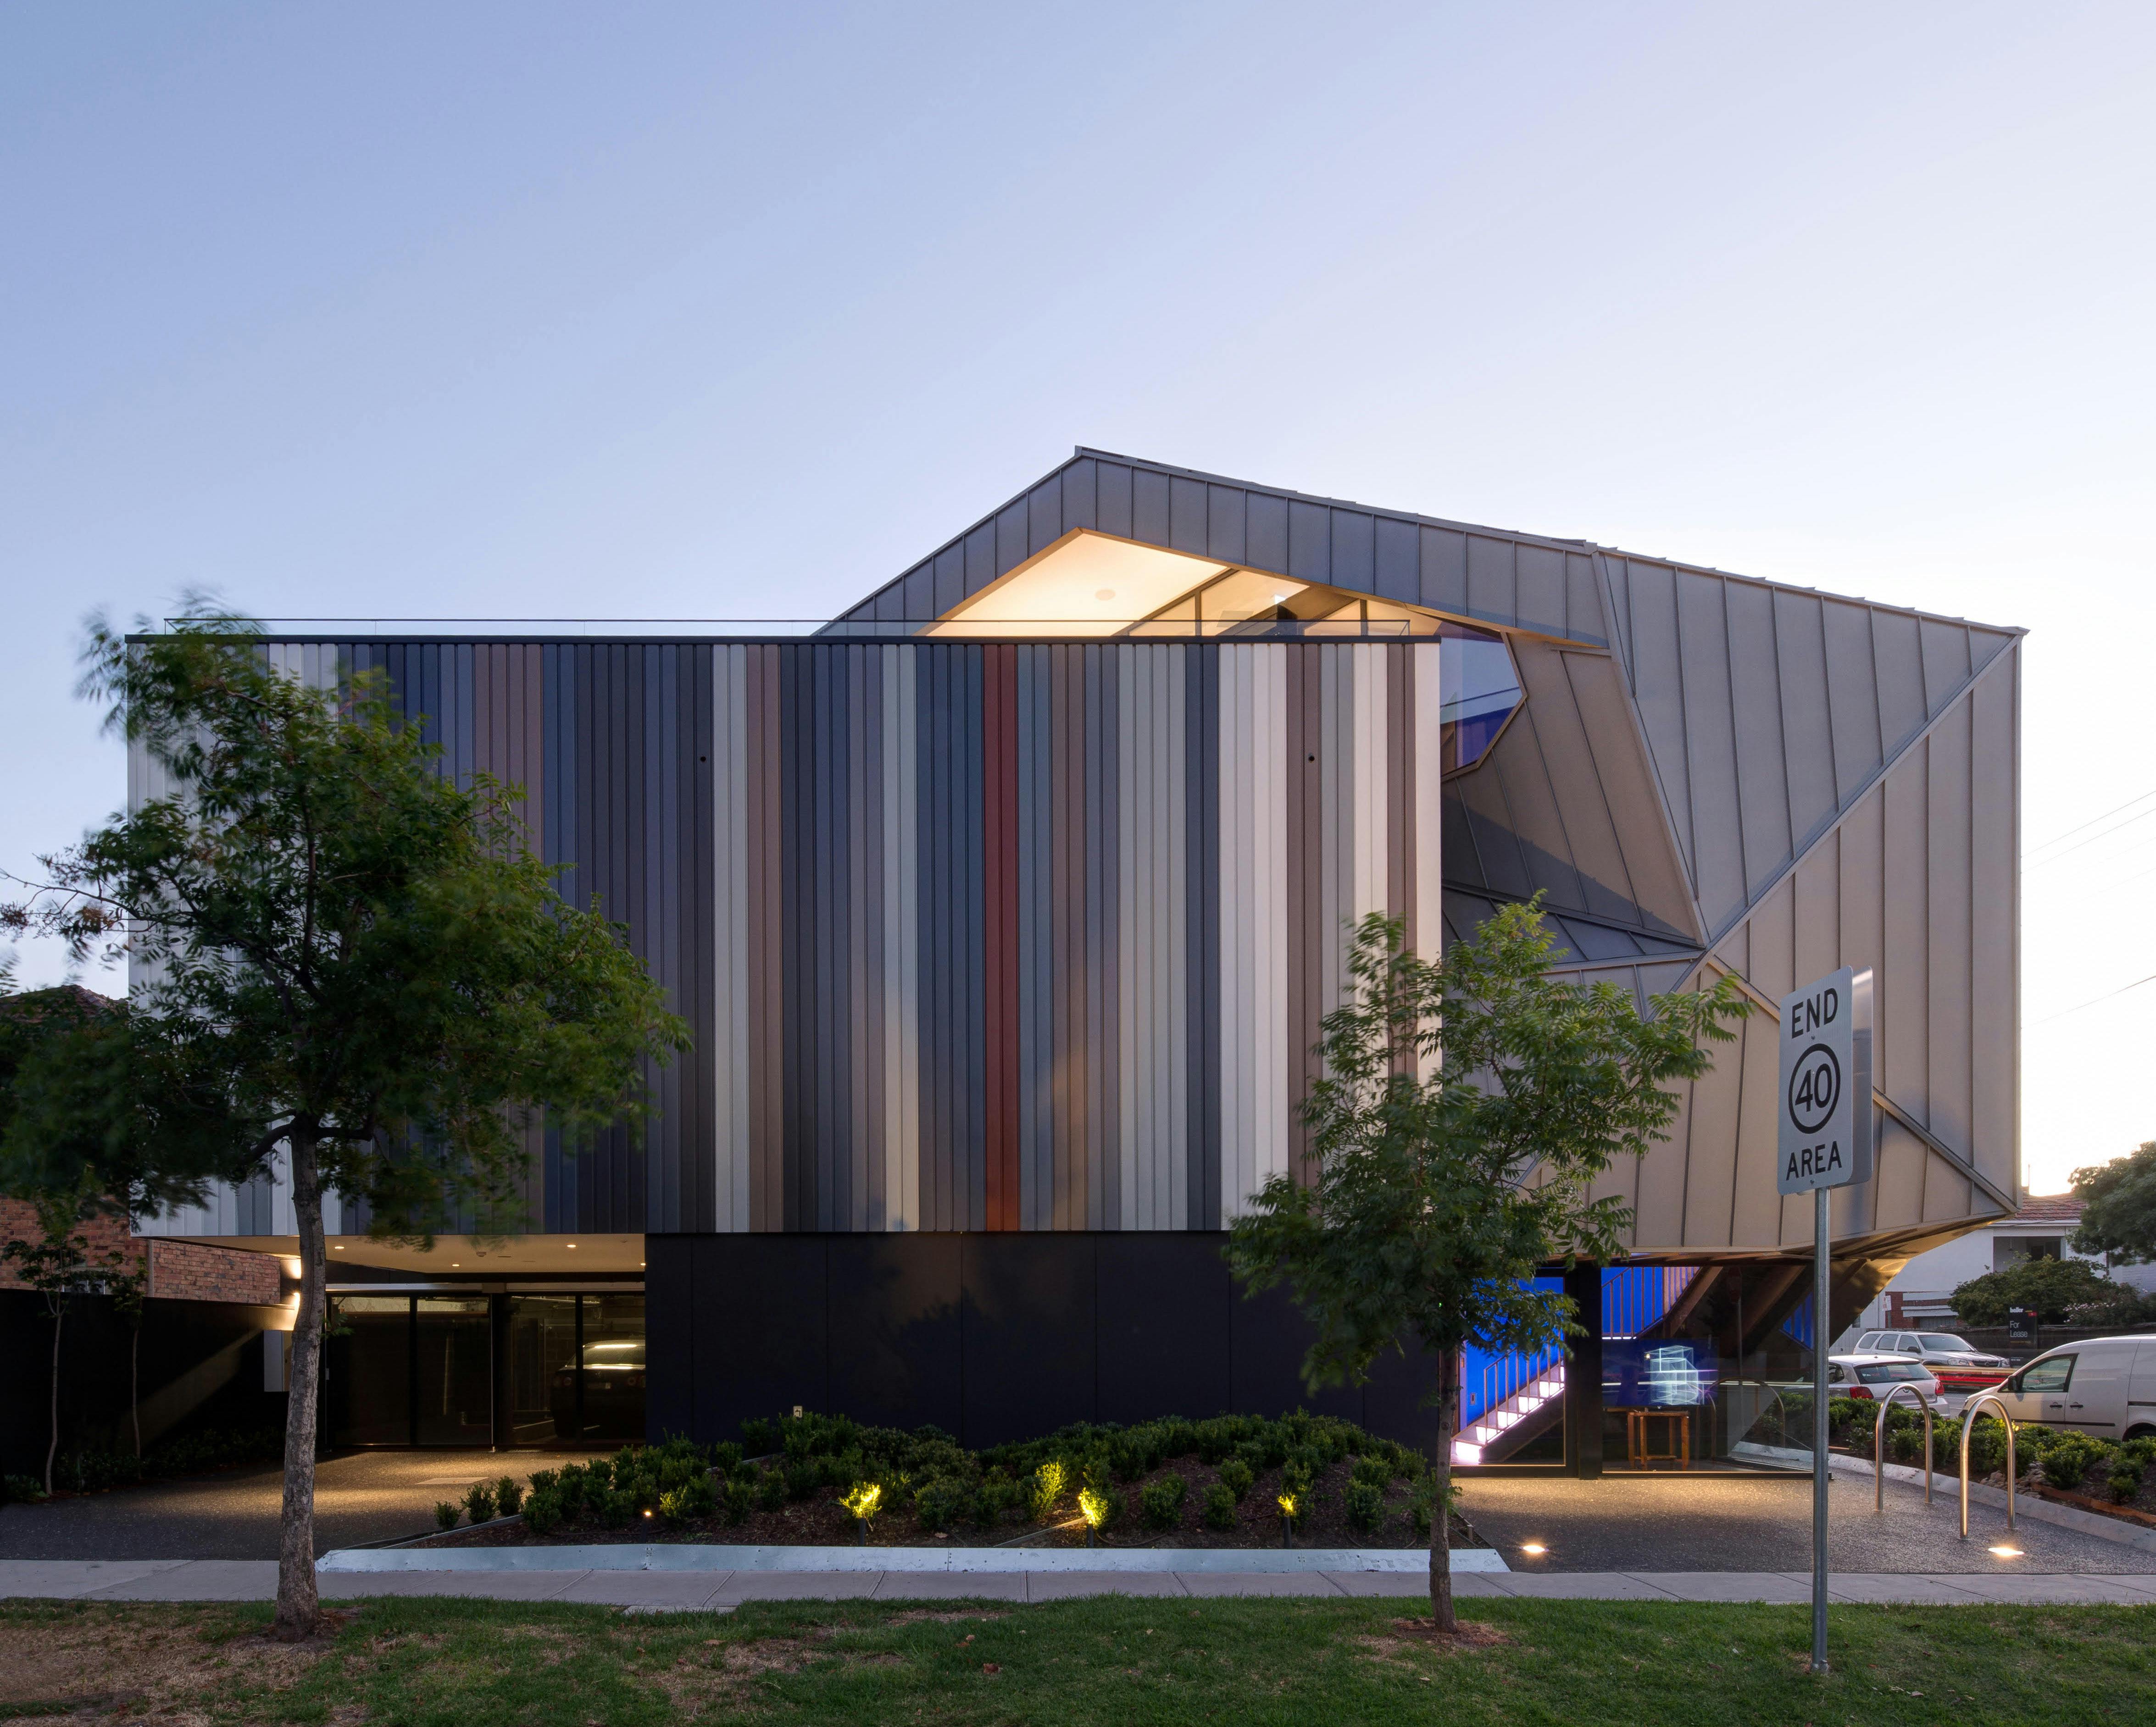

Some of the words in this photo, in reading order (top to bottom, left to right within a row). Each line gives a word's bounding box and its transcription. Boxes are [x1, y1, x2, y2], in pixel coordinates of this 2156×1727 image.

[1791, 988, 1838, 1039] END
[1795, 1063, 1832, 1112] 40
[1786, 1141, 1842, 1181] AREA
